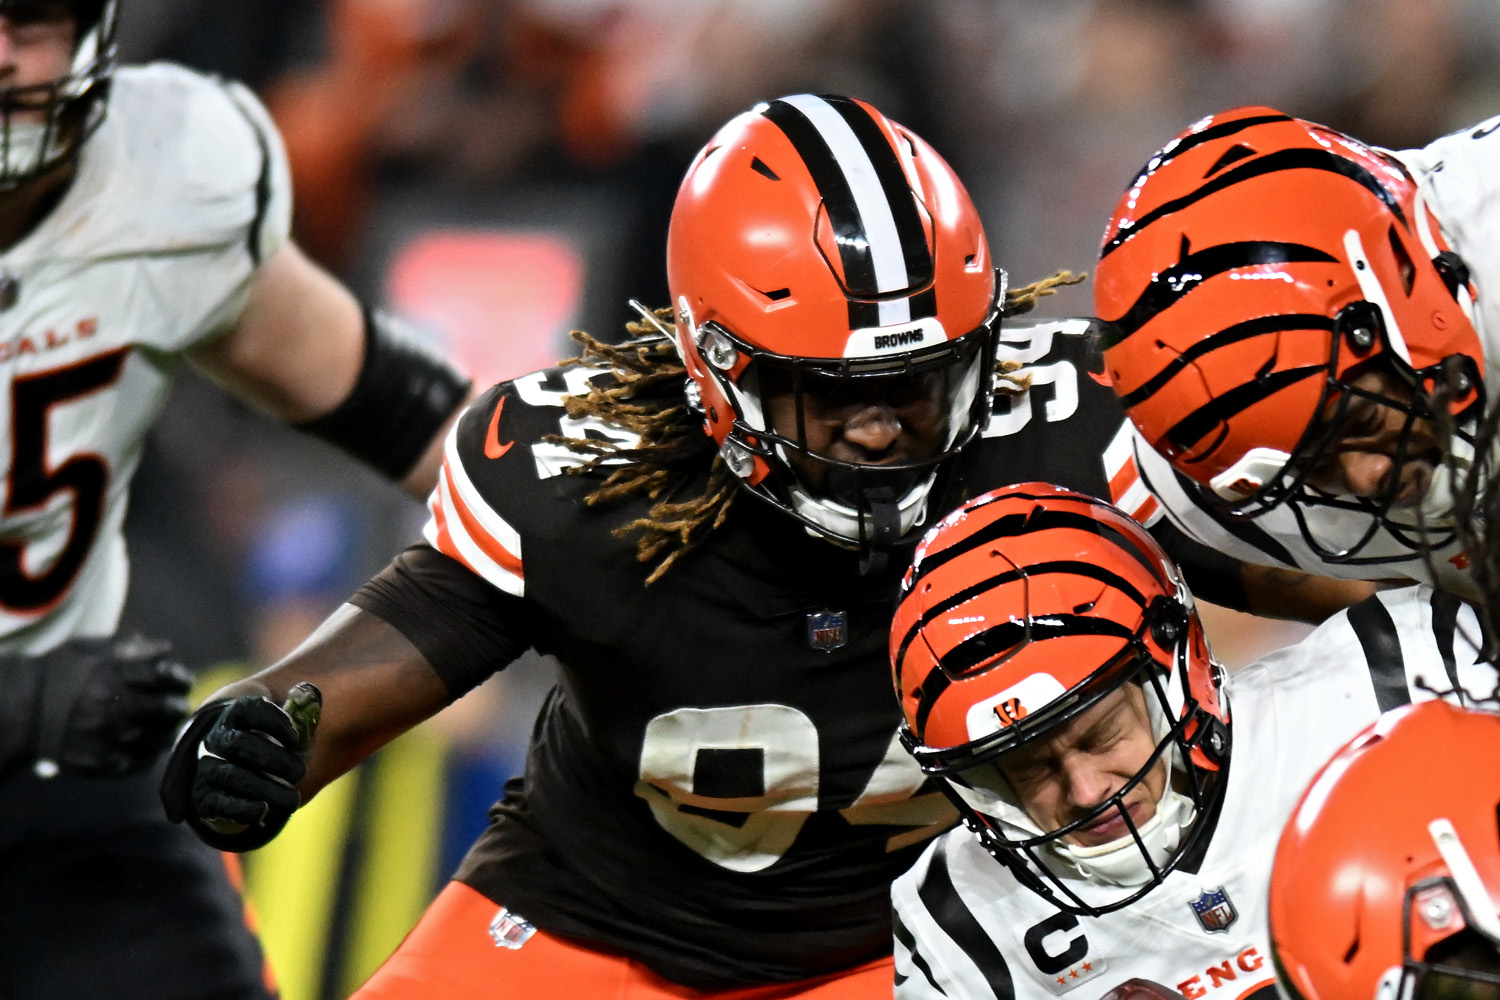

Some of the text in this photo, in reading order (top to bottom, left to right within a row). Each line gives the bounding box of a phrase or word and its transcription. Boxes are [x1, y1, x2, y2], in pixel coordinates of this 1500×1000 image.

[874, 327, 924, 350] BROWNS
[1201, 904, 1233, 928] NFL
[1024, 911, 1089, 975] C
[1177, 946, 1265, 1000] ENG
